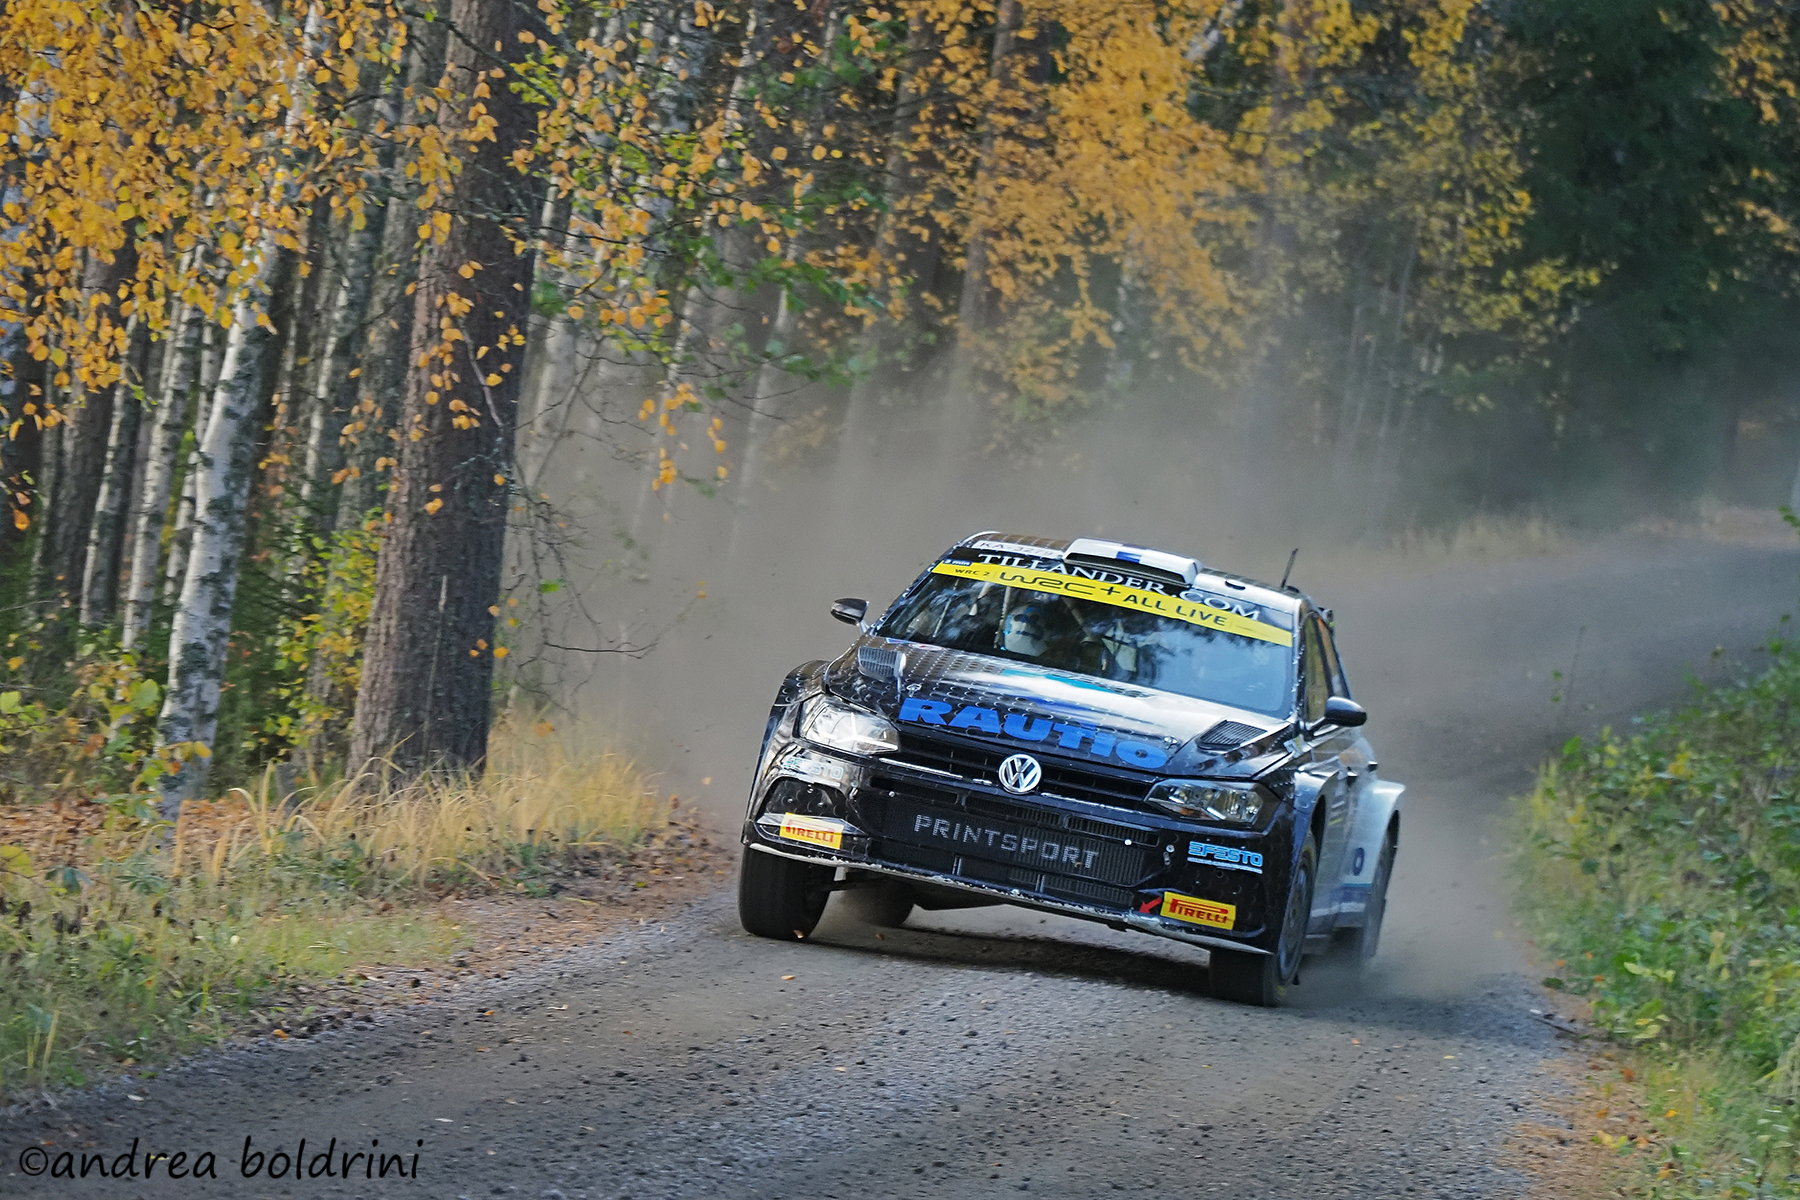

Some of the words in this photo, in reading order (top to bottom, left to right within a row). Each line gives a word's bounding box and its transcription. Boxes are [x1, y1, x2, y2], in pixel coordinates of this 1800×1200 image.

[955, 568, 980, 576] WRC
[978, 553, 1260, 621] TILLANDER.COM
[1123, 594, 1167, 611] ALL
[1175, 605, 1228, 626] LIVE
[898, 697, 1168, 769] RAUTIO
[785, 818, 836, 843] PIRELLI
[914, 814, 1099, 869] PRINTSPORT
[1188, 841, 1263, 867] EFESTO
[1168, 897, 1229, 924] PIRELLI
